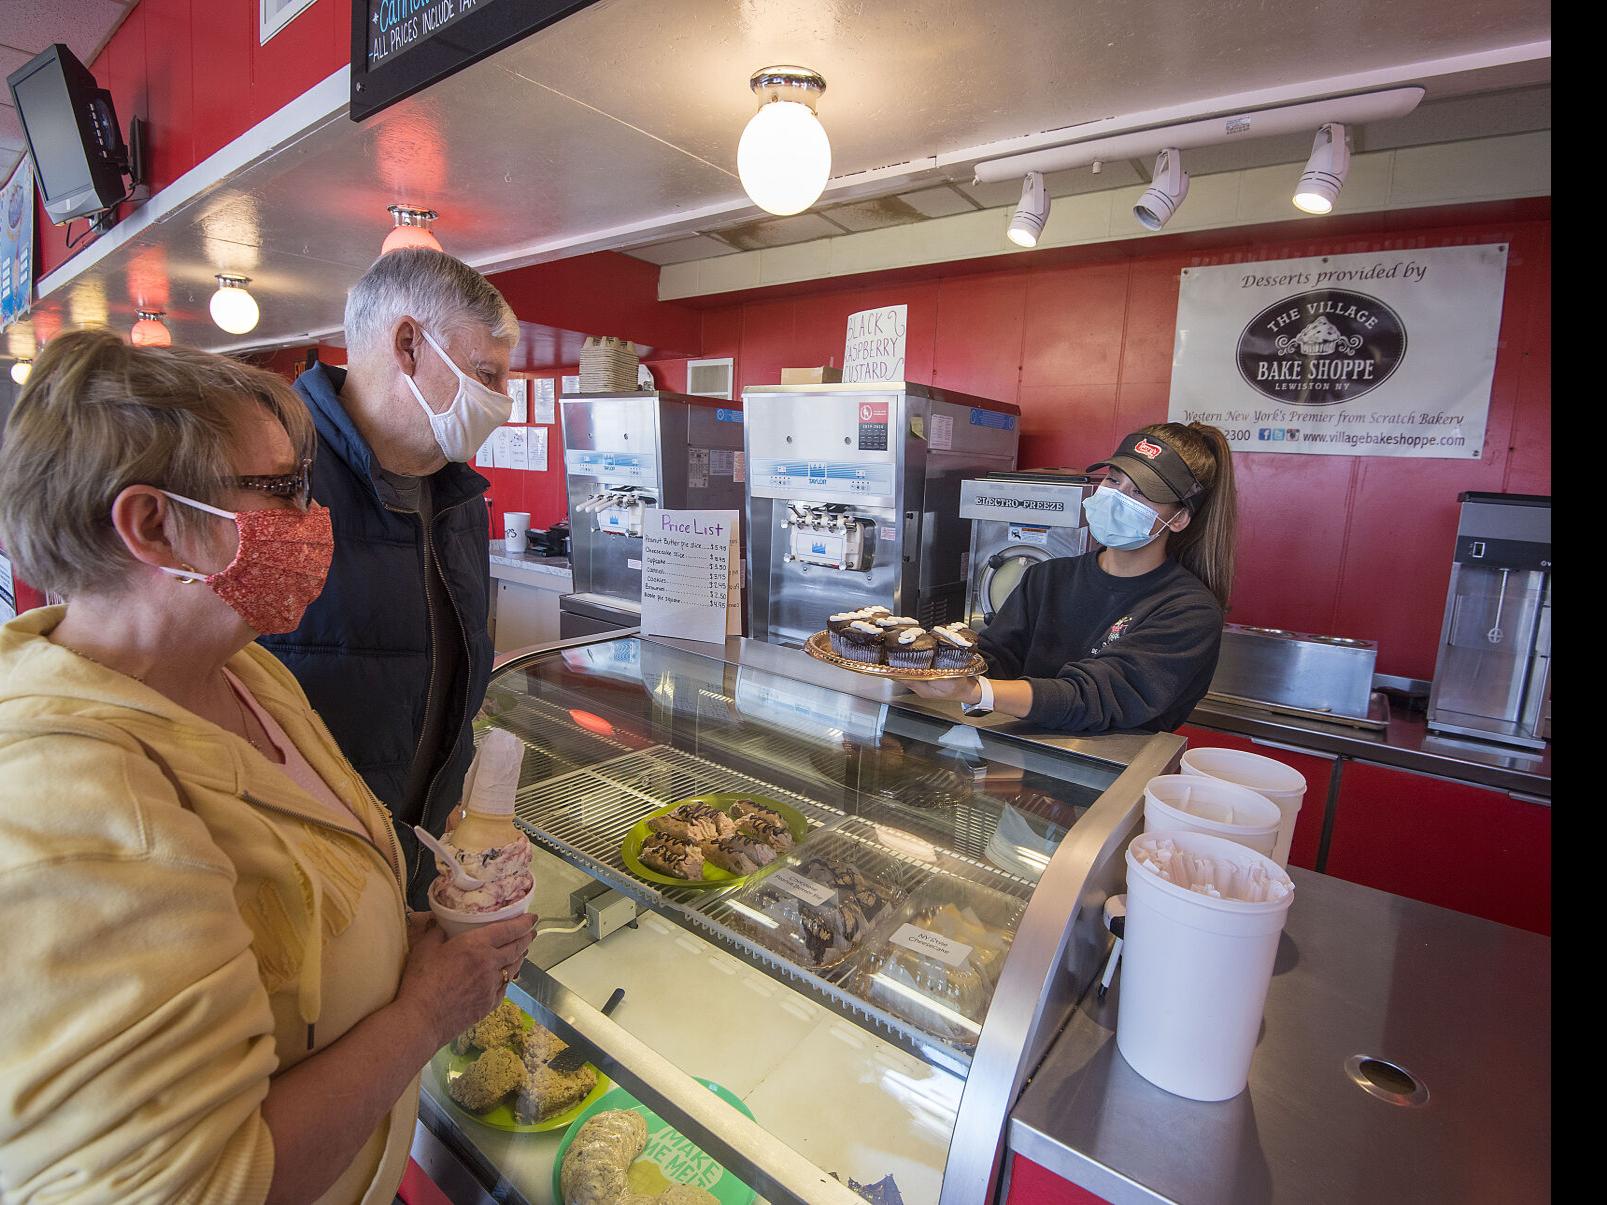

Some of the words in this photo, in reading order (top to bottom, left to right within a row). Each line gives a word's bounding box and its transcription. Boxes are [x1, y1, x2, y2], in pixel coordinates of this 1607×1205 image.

[391, 16, 418, 52] PRICES
[422, 0, 455, 35] INCLUDE
[1241, 271, 1311, 288] Desserts
[1311, 262, 1397, 287] provided
[1403, 261, 1427, 282] by
[1267, 307, 1301, 332] THE
[1306, 301, 1378, 329] VILLAGE
[845, 337, 898, 362] ASPBERRY
[1257, 360, 1302, 380] BAKE
[1308, 359, 1375, 380] SHOPPE
[1184, 410, 1222, 422] Western
[1225, 409, 1250, 422] New
[1253, 408, 1285, 424] York's
[1289, 409, 1336, 423] Premier
[1336, 410, 1366, 426] from
[1369, 411, 1415, 425] Scratch
[1418, 411, 1465, 425] Bakery
[1303, 431, 1466, 448] www.villagebakeshoppe.com
[1023, 500, 1064, 511] FREEZE
[661, 514, 690, 533] Price
[693, 518, 724, 536] List
[660, 1129, 720, 1184] MAKE
